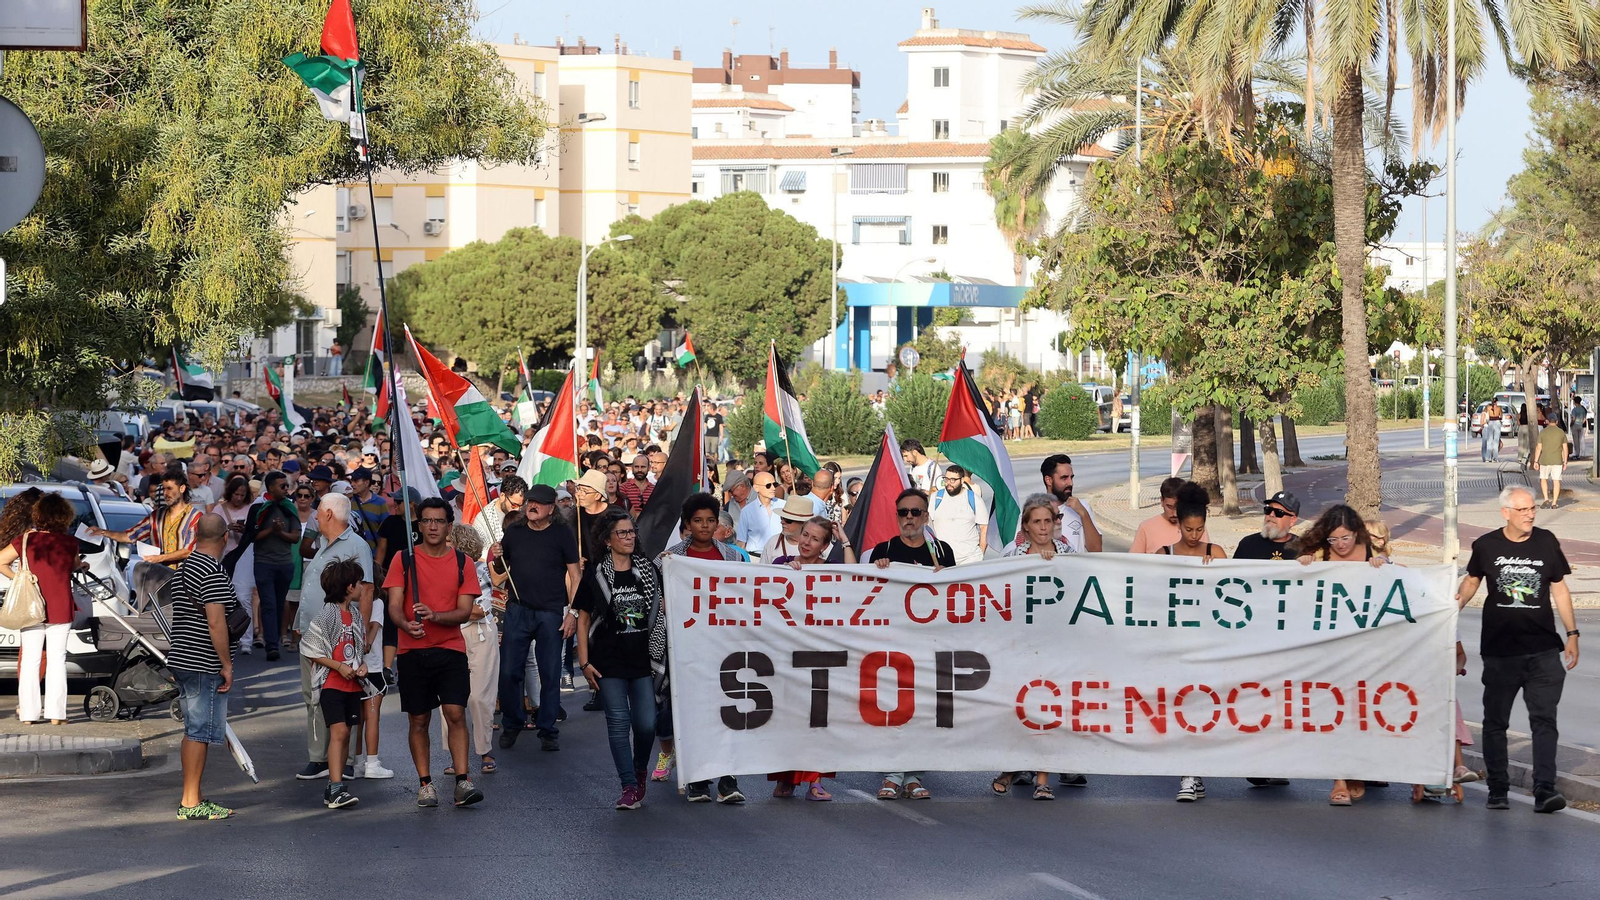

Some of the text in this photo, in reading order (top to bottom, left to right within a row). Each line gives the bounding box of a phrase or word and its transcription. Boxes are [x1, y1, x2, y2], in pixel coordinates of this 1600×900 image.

[683, 575, 1417, 631] JEREZ CON PALESTINA
[719, 650, 1419, 734] STOP GENOCIDIO
